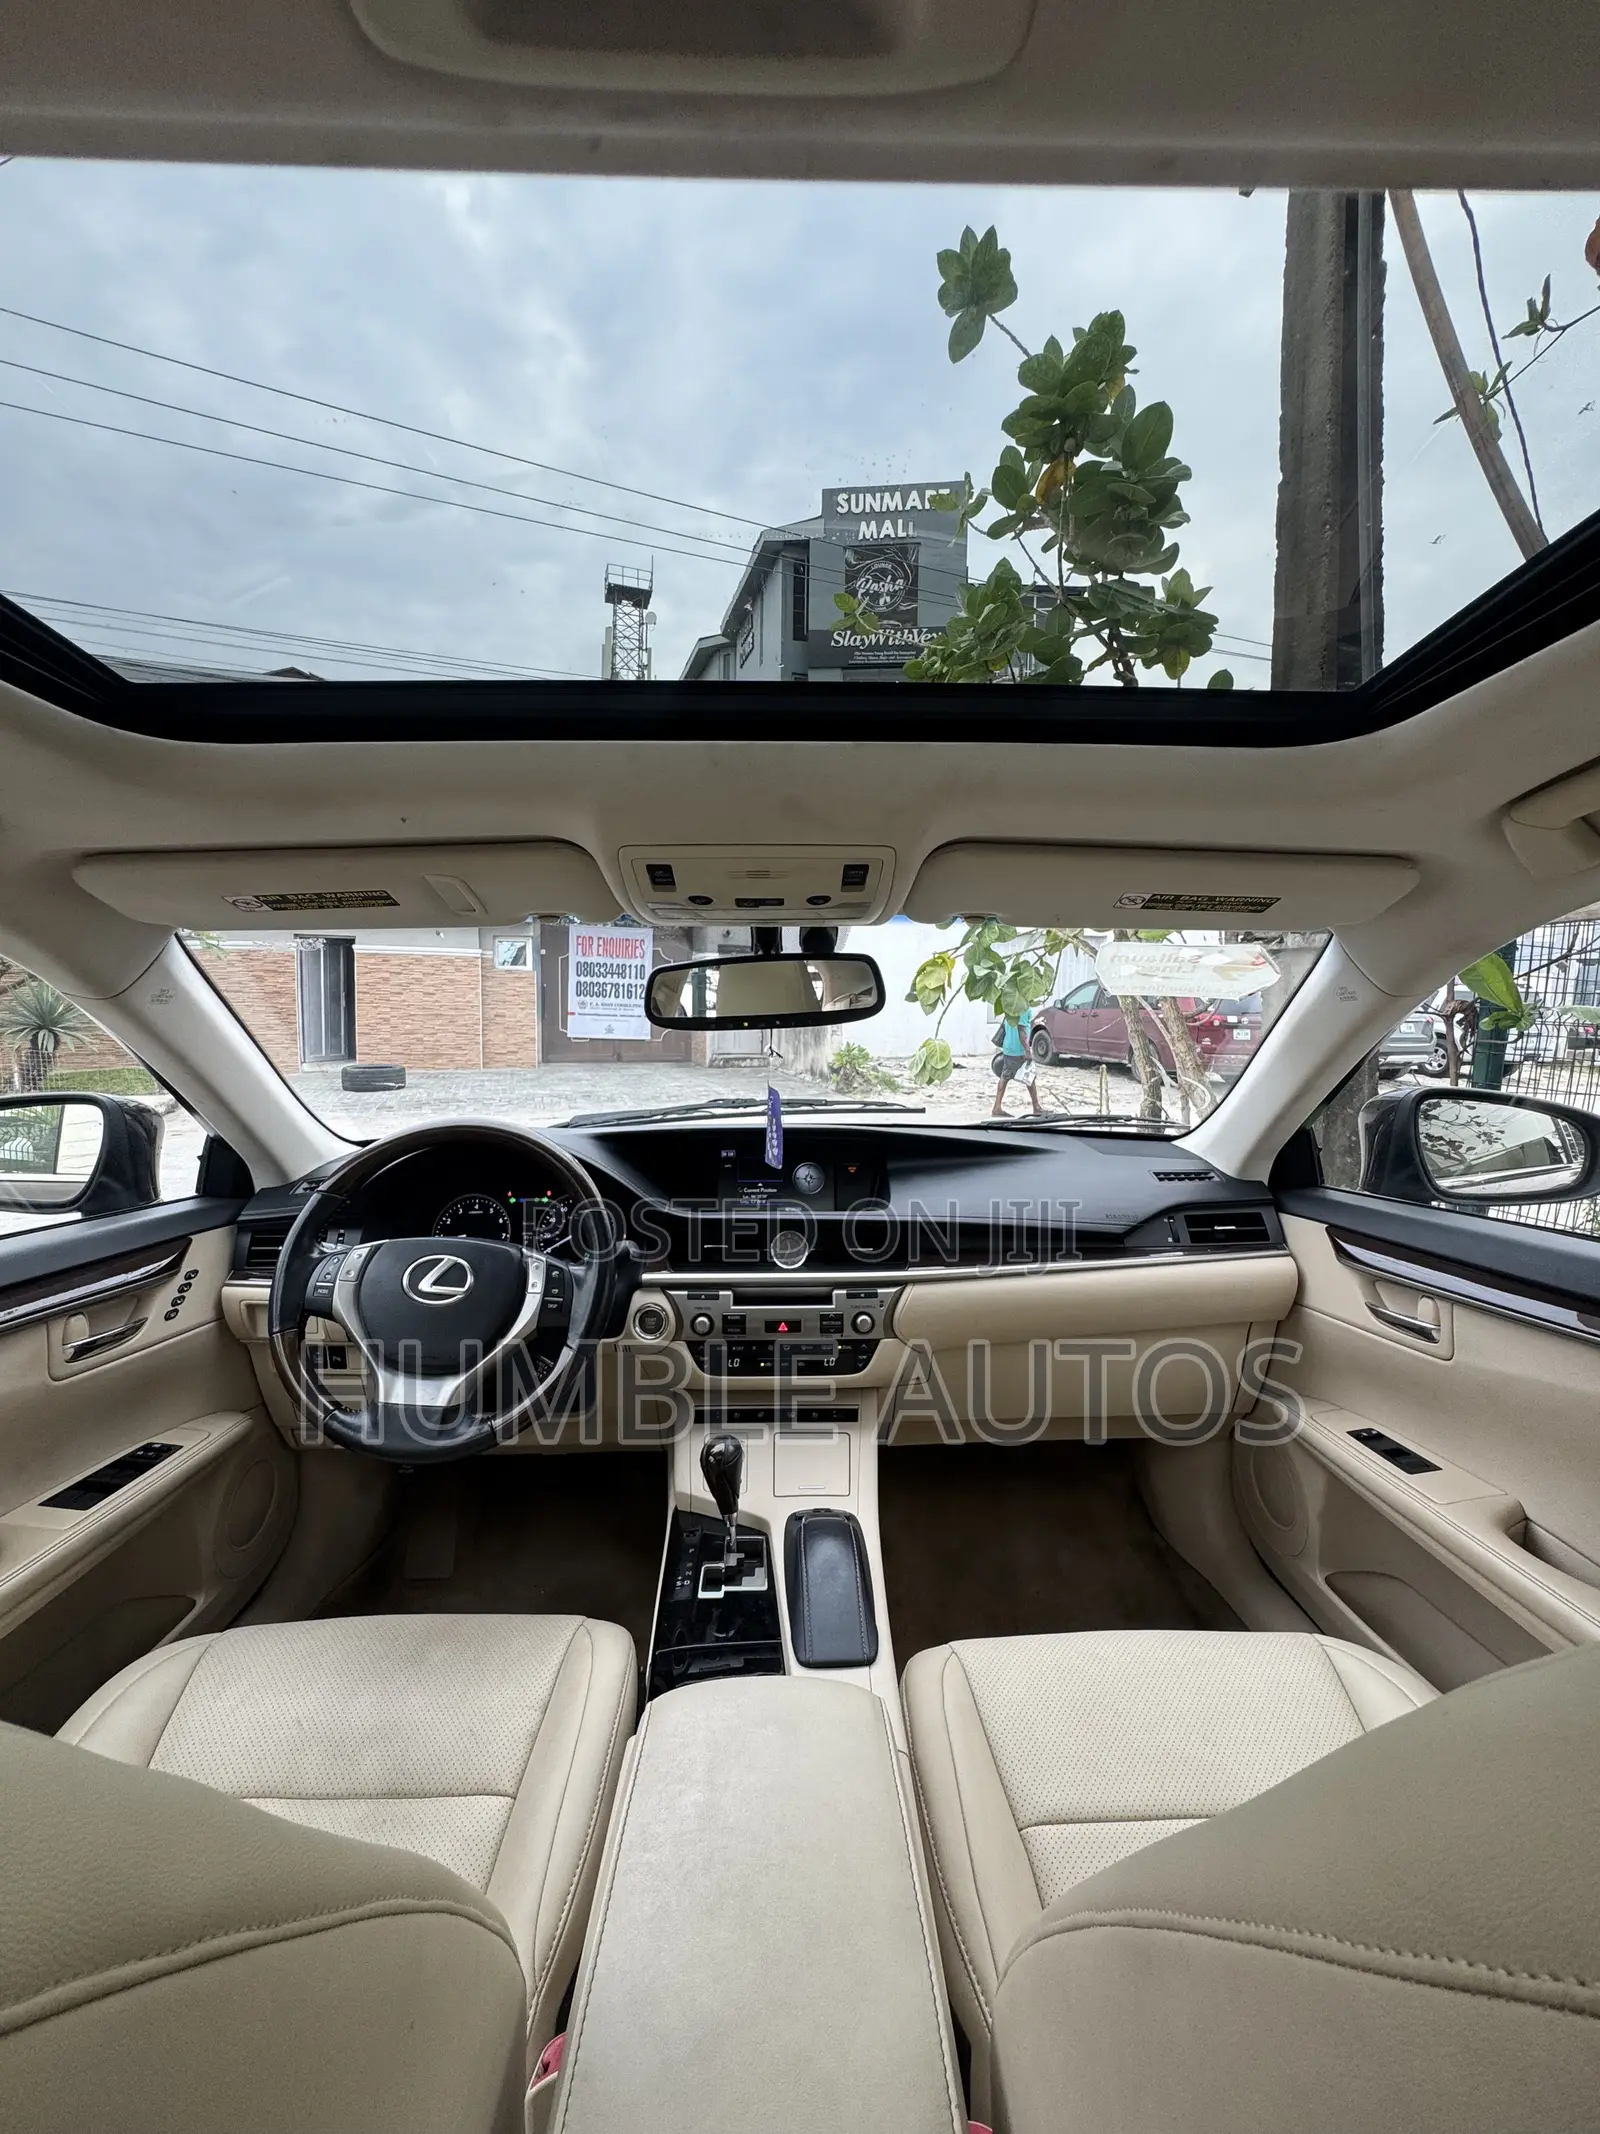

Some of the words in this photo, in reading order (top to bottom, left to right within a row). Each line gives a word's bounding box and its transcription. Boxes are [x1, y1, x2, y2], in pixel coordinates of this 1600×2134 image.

[836, 488, 950, 514] SUNMAR
[323, 890, 389, 898] WARNING
[1215, 896, 1278, 904] WARNING
[575, 935, 595, 957] FOR
[596, 936, 646, 960] ENQUIRIES
[575, 961, 646, 981] 08033448110
[575, 980, 646, 1000] 08036781612
